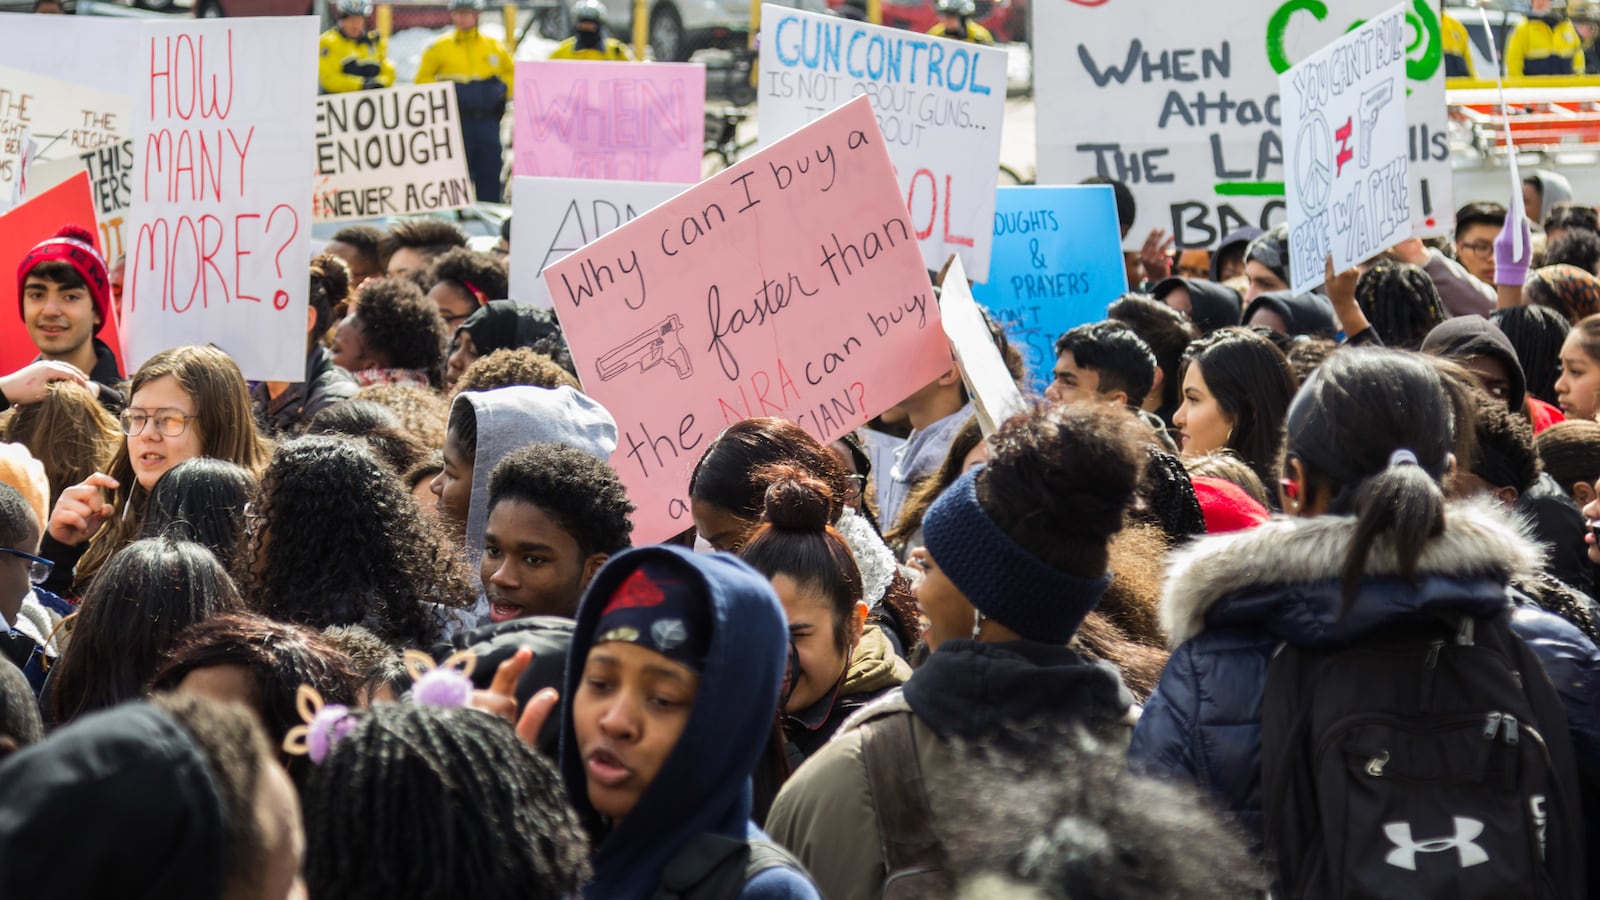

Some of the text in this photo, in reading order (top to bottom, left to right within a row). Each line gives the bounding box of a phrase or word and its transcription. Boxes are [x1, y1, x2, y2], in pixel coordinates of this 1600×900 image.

[151, 29, 233, 120] HOW
[775, 16, 991, 95] GUN CONTROL
[1077, 38, 1231, 87] WHEN
[767, 71, 793, 98] IS
[799, 72, 842, 102] NOT
[81, 109, 117, 131] THE
[316, 89, 450, 138] ENOUGH
[523, 78, 690, 151] WHEN
[79, 140, 134, 180] THIS
[144, 125, 255, 203] MANY
[317, 127, 454, 175] ENOUGH
[1076, 143, 1176, 183] THE
[406, 177, 471, 212] AGAIN
[560, 249, 647, 310] Why
[660, 203, 726, 257] can
[730, 170, 761, 214] I
[768, 145, 837, 192] buy
[847, 129, 869, 150] a
[131, 203, 299, 314] MORE?
[1029, 237, 1048, 269] &
[708, 217, 910, 382] faster than
[1011, 272, 1090, 300] PRAYERS
[626, 292, 927, 478] the NRA can buy
